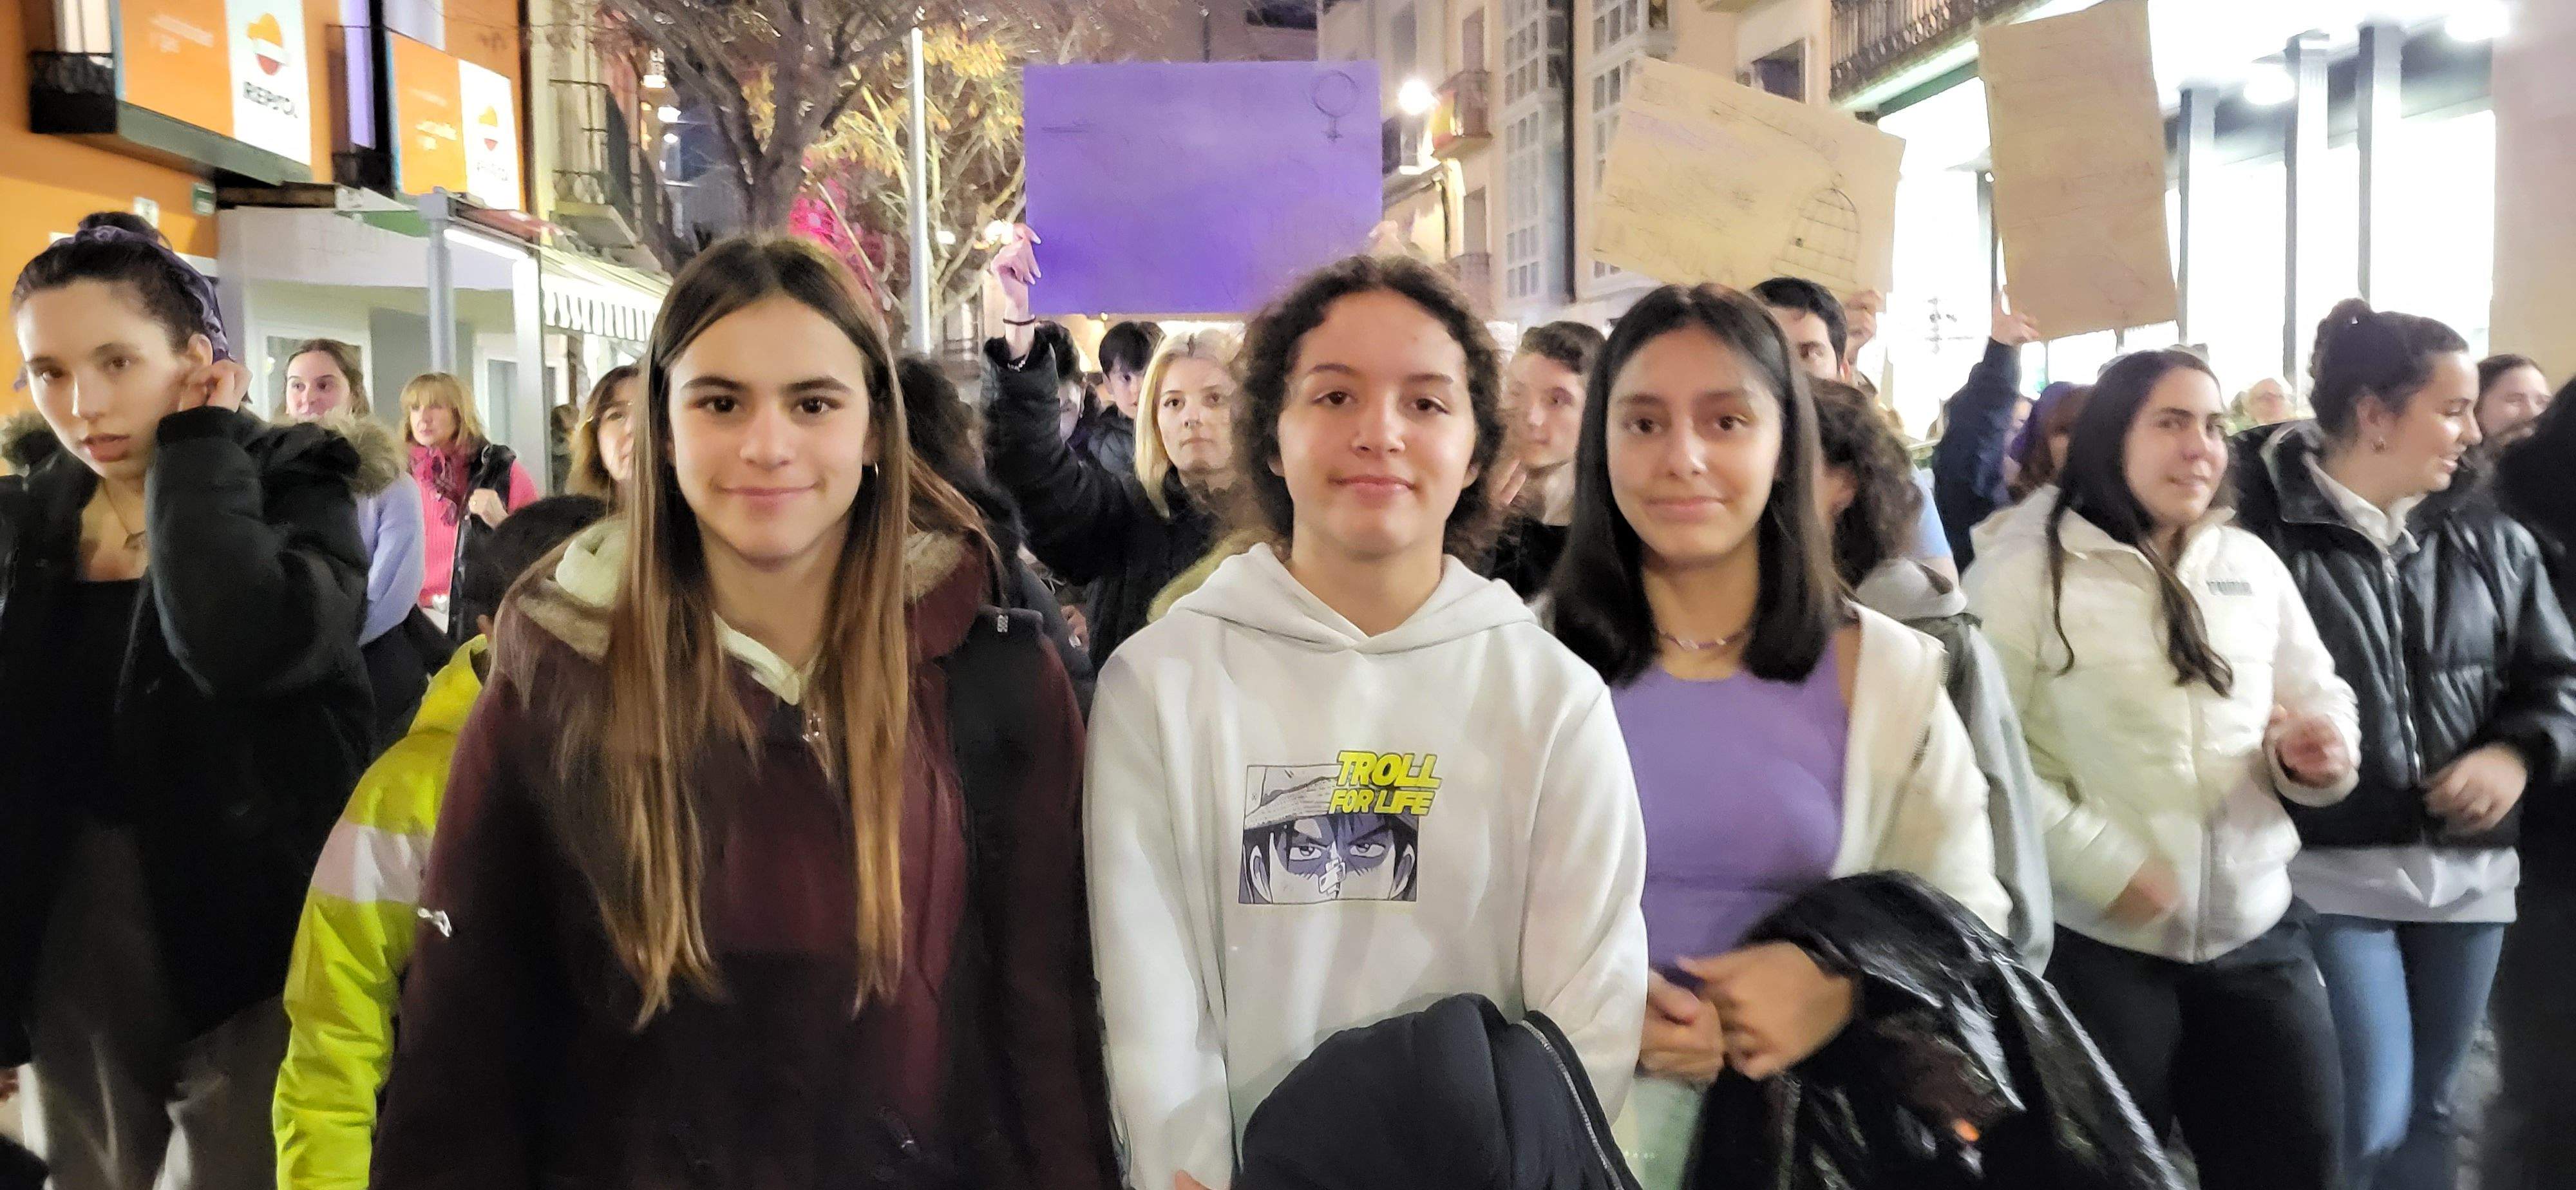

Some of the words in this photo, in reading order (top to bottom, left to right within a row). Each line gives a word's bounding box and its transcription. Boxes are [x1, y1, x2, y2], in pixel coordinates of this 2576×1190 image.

[1338, 750, 1441, 789] TROLL
[1329, 788, 1374, 814] FOR
[1373, 789, 1435, 815] LIFE
